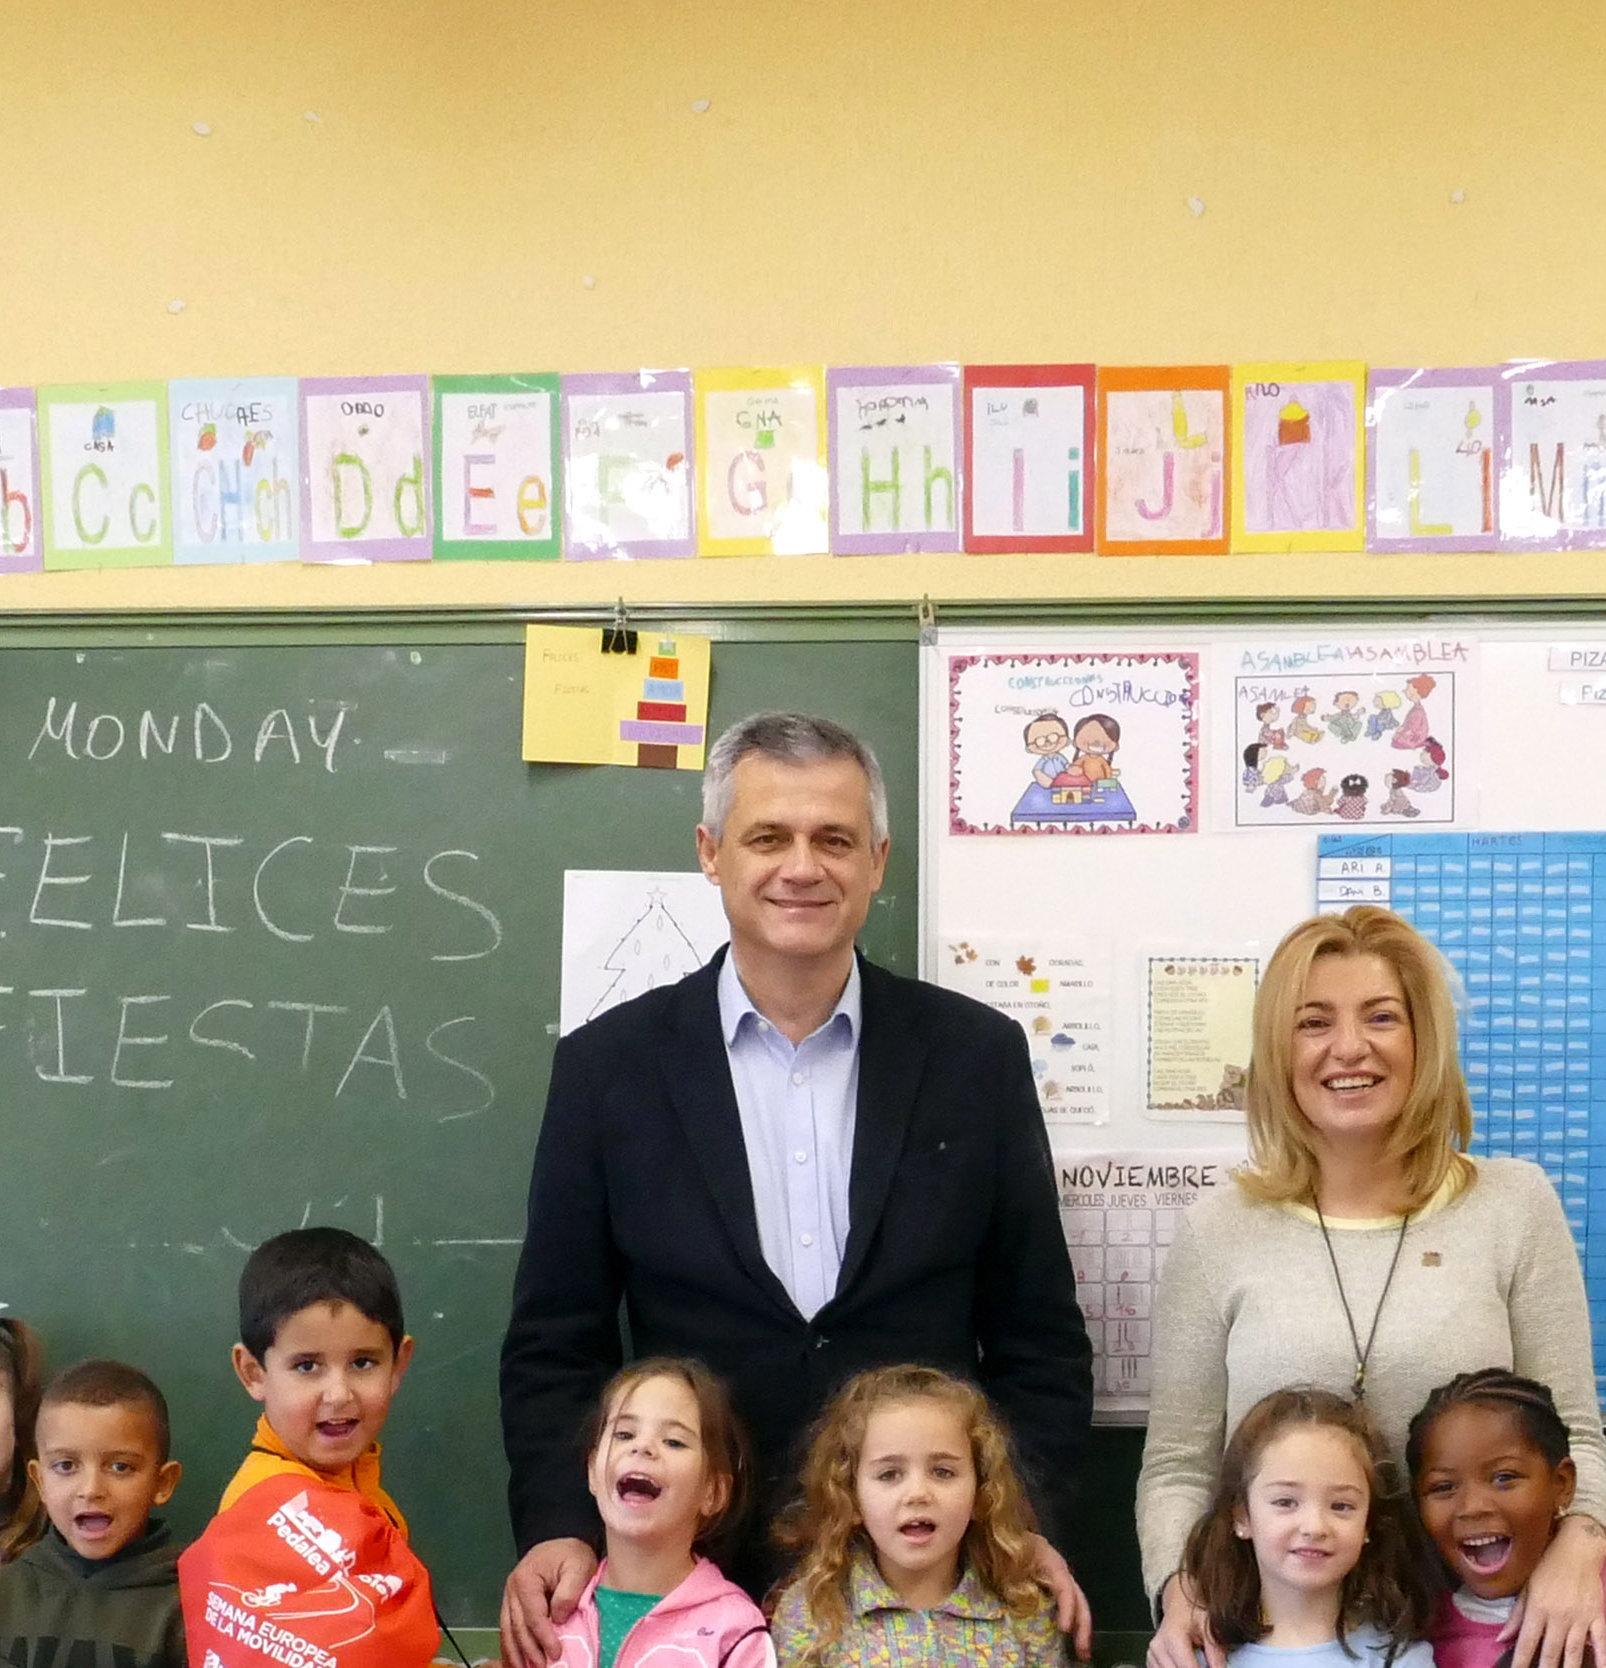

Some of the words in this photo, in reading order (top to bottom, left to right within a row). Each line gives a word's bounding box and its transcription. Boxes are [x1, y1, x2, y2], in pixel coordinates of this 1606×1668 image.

[1061, 1160, 1218, 1190] NOVIEMBRE
[1106, 1194, 1147, 1208] JUEVES
[267, 1509, 331, 1577] Pedalea
[204, 1606, 218, 1629] DE
[217, 1615, 235, 1637] LA
[207, 1591, 258, 1632] SEMANA
